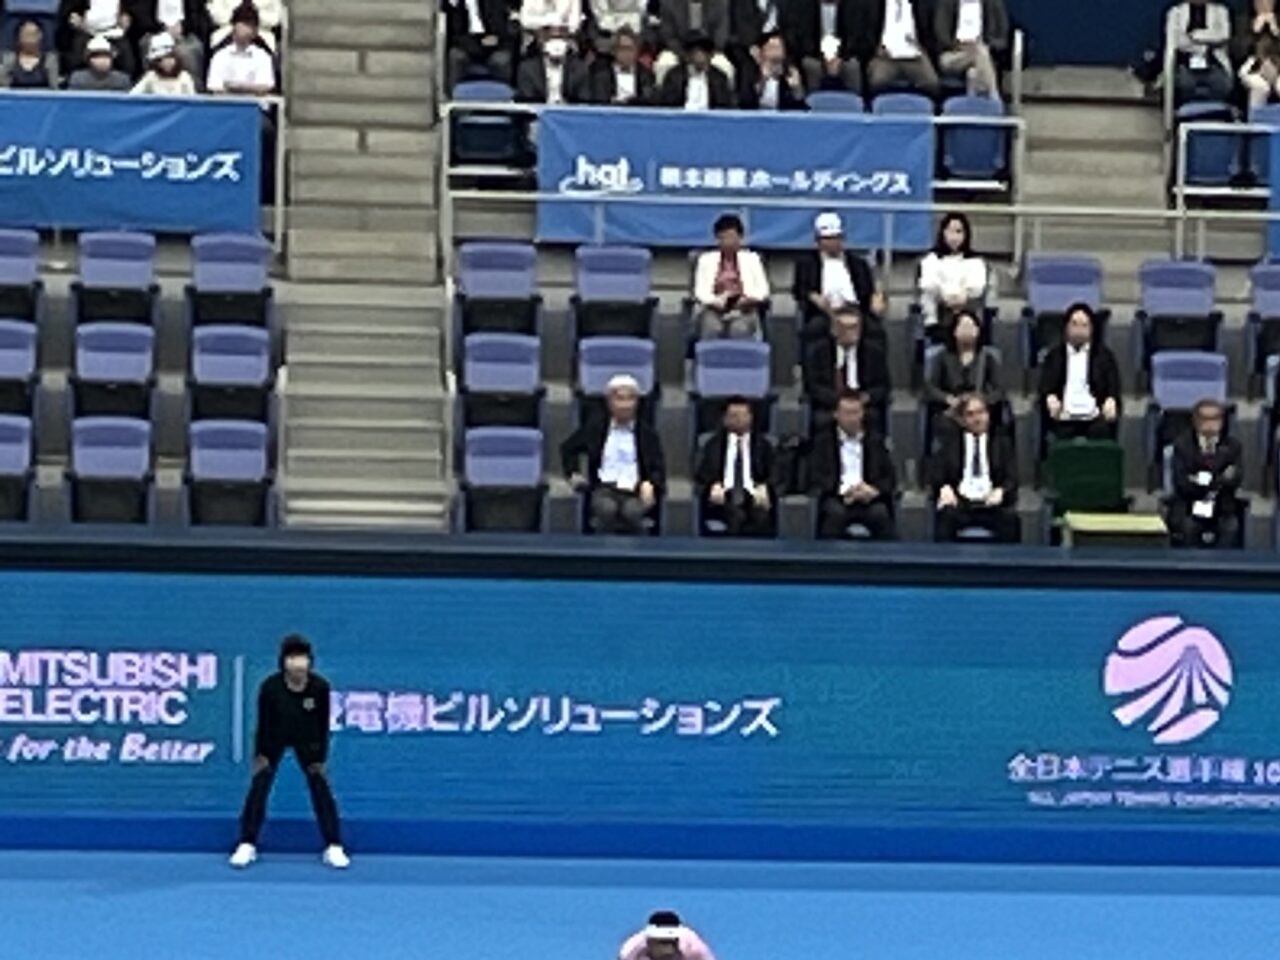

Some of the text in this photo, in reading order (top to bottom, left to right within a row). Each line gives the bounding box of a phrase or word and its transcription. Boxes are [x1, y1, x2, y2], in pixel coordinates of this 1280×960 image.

[0, 651, 217, 688] MITSUBISHI
[0, 688, 187, 725] ELECTRIC
[6, 732, 215, 764] for the Better
